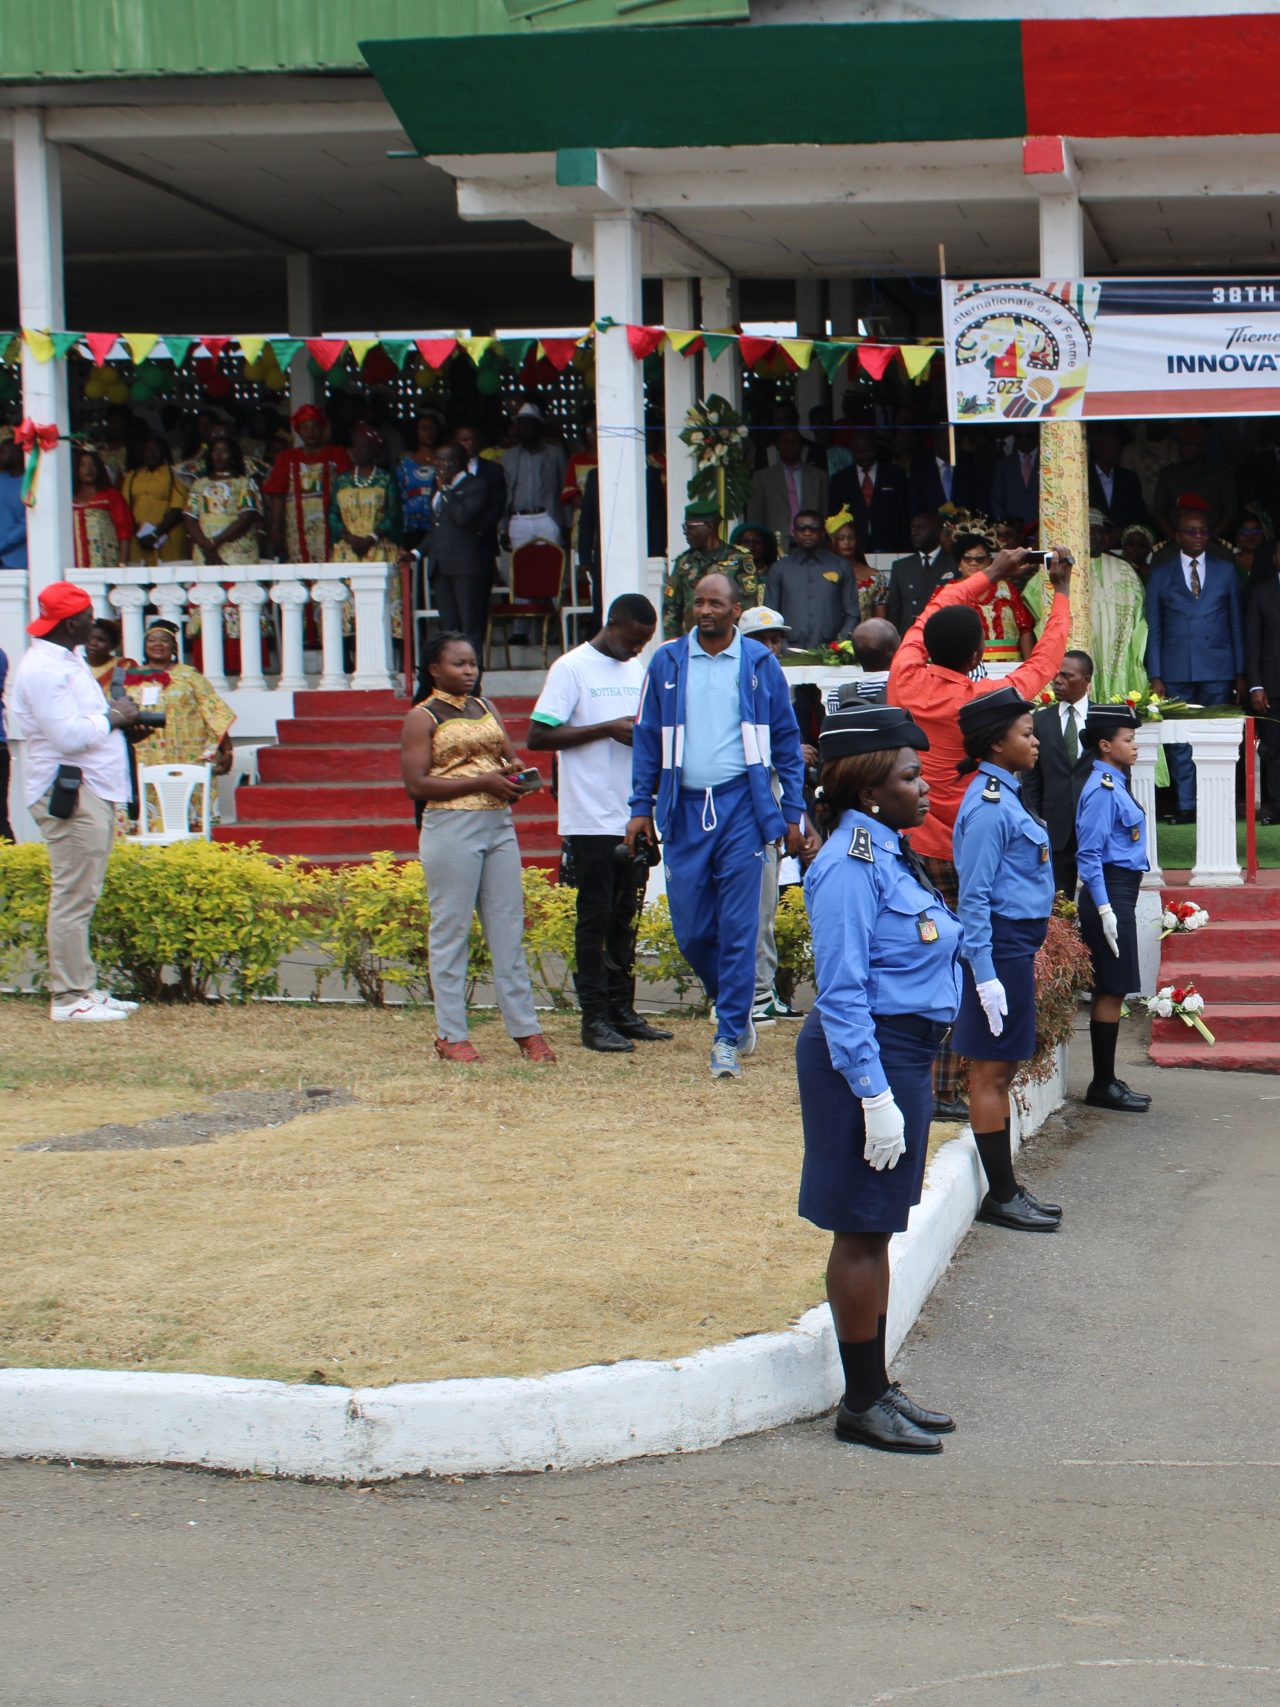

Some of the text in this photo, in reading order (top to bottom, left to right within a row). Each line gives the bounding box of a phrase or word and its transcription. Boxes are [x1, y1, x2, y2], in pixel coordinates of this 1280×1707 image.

[1212, 286, 1275, 304] 38TH
[1037, 304, 1052, 316] de
[1052, 314, 1063, 326] la
[1061, 325, 1077, 368] Femme
[987, 379, 1024, 395] 2023
